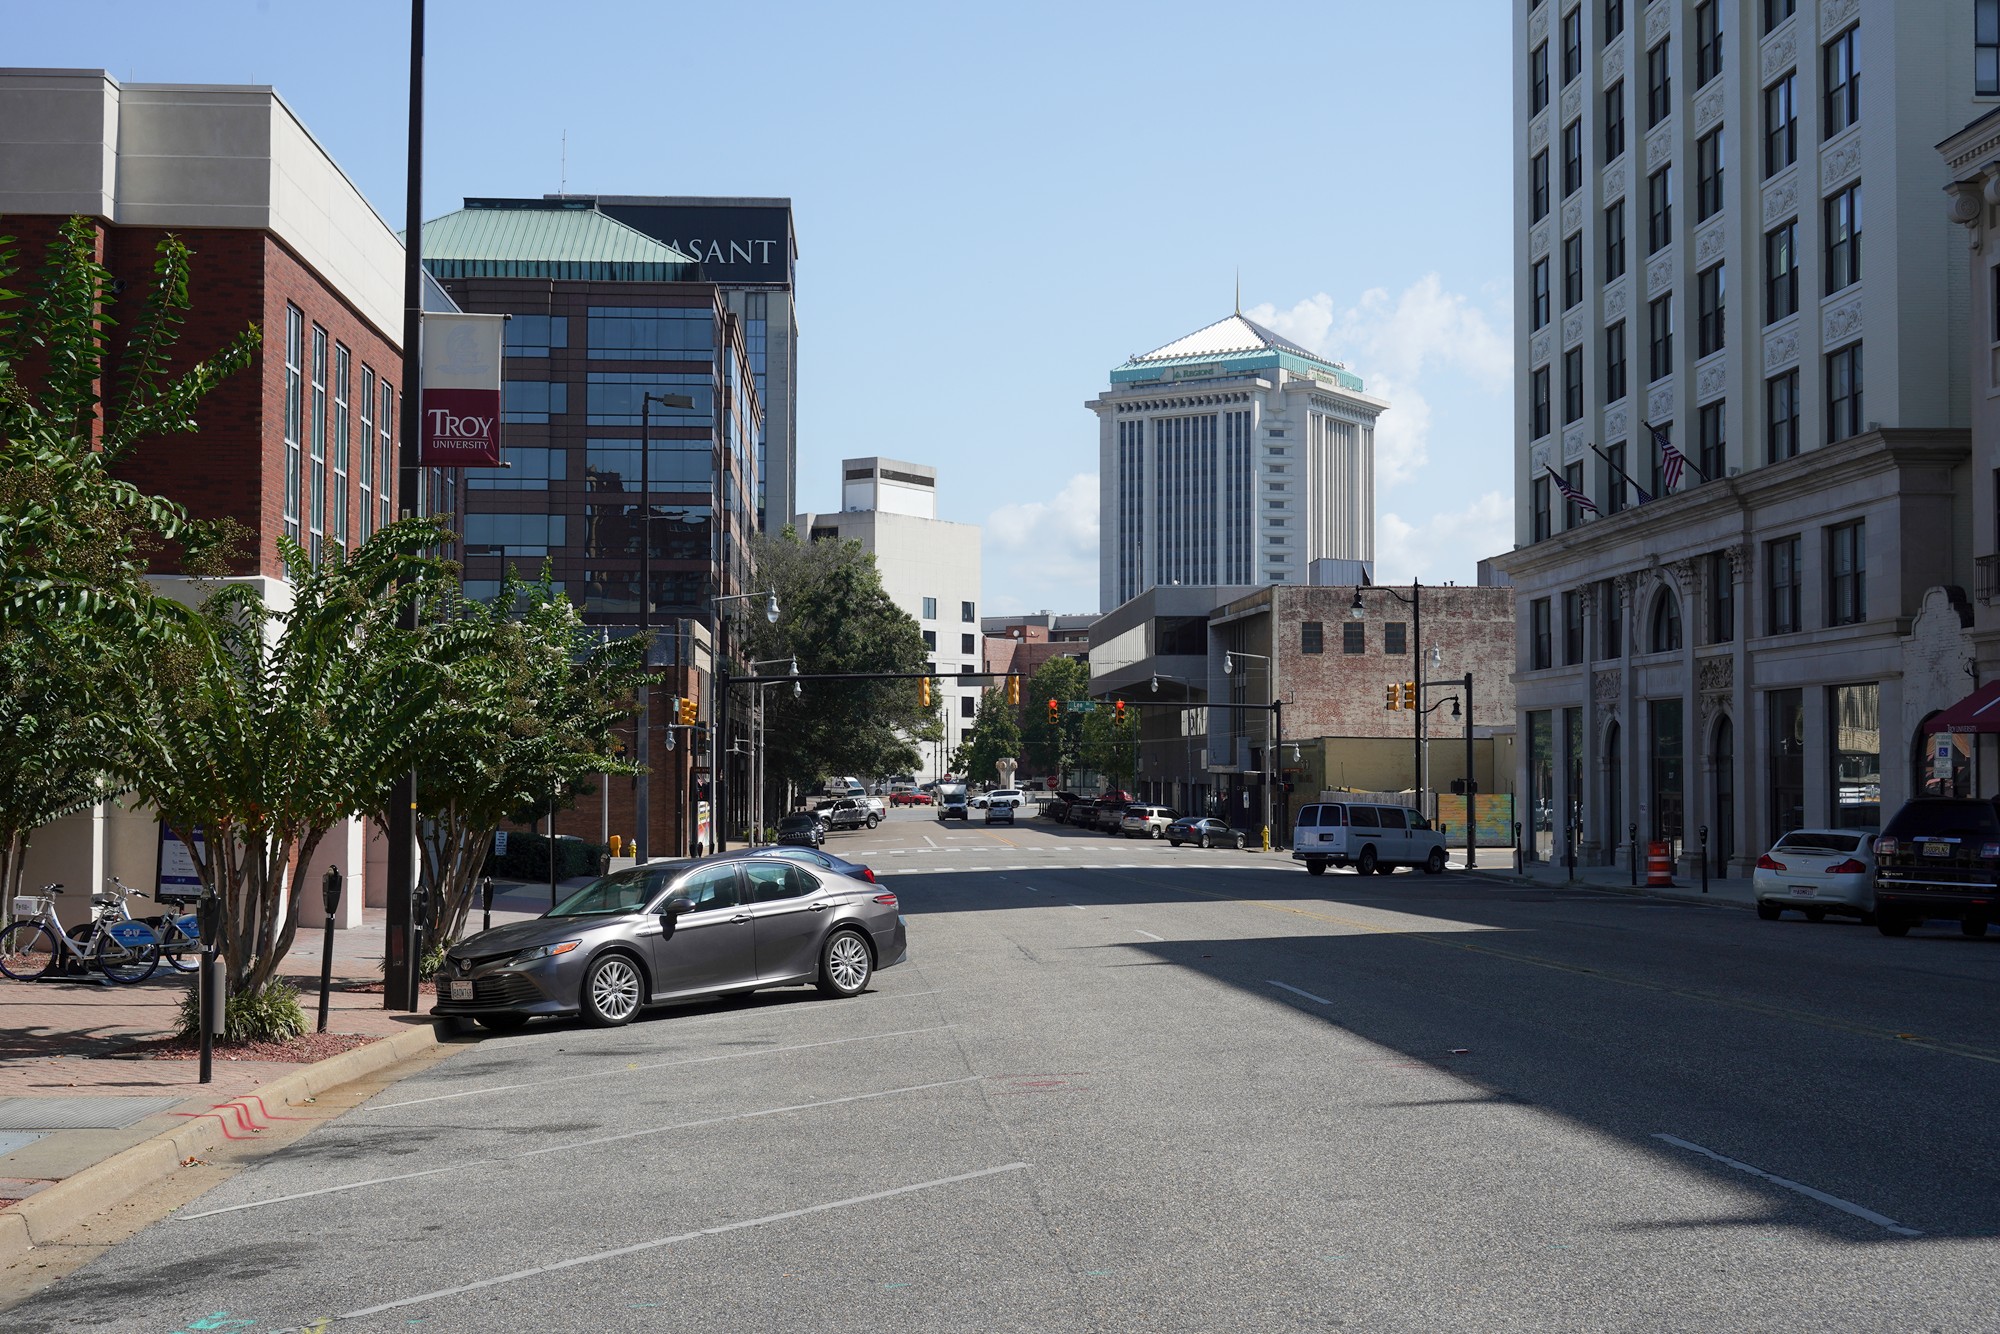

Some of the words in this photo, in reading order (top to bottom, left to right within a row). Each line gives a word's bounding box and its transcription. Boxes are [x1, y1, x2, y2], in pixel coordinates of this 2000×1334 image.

[660, 239, 777, 264] ASANT
[1183, 368, 1214, 377] REGIONS
[428, 409, 494, 437] TROY
[433, 440, 489, 449] UNIVERSITY
